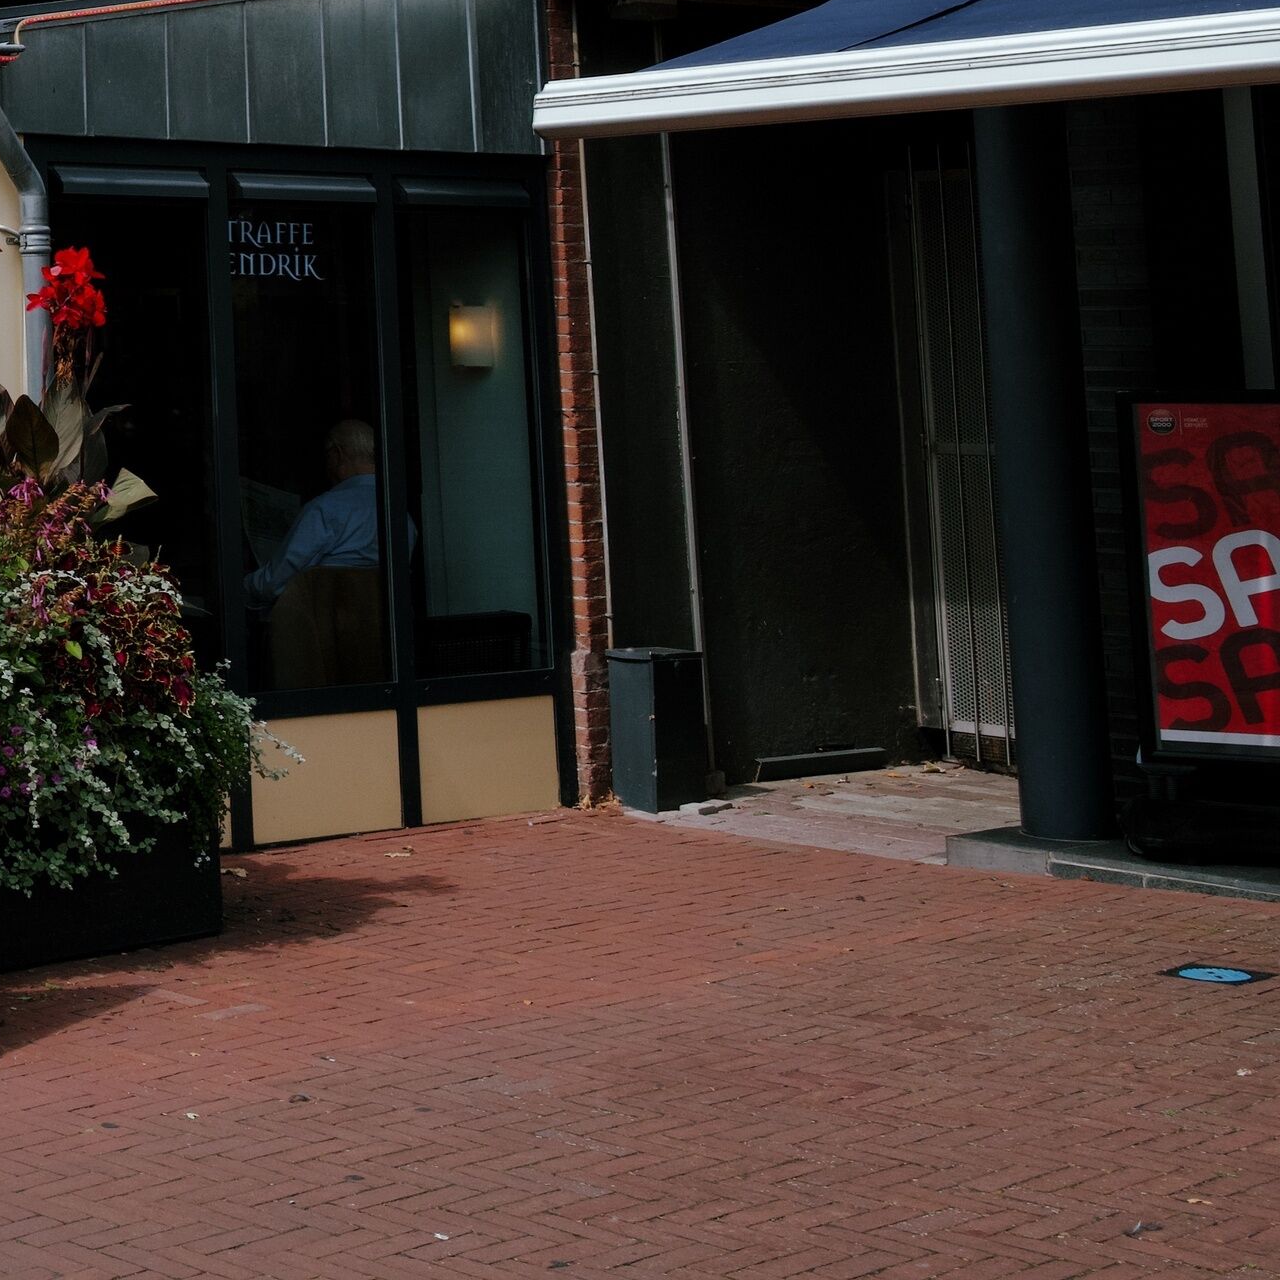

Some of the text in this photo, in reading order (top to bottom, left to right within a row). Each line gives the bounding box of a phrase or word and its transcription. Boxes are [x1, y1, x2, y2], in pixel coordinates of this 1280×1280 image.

[226, 219, 314, 249] TRAFFE
[229, 247, 327, 281] ENDRIK
[1142, 431, 1280, 540] SA
[1147, 529, 1280, 641] SA
[1156, 628, 1280, 731] SA
